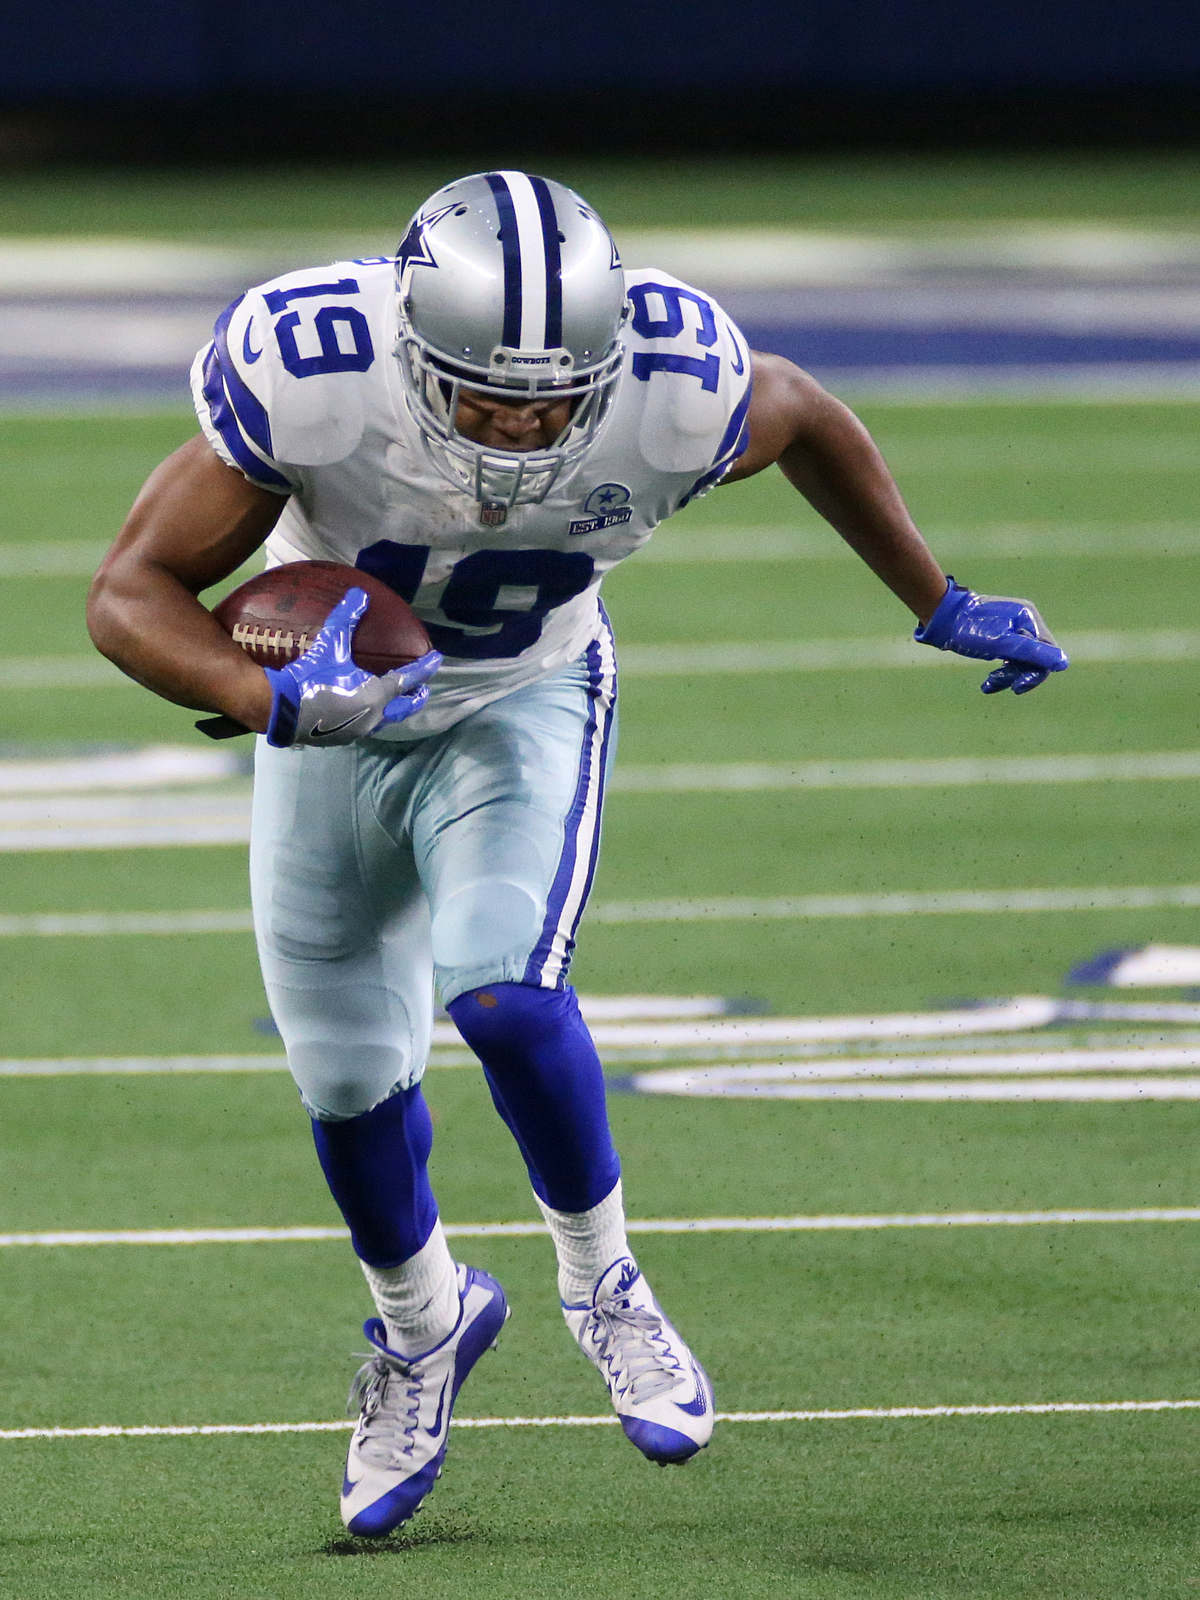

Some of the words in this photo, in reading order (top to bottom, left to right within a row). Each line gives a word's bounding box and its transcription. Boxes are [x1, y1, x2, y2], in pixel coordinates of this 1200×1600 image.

[261, 278, 375, 379] 19
[627, 281, 720, 392] 19
[511, 356, 551, 364] COWBOYS
[572, 520, 599, 534] EST.
[604, 512, 630, 527] 1960
